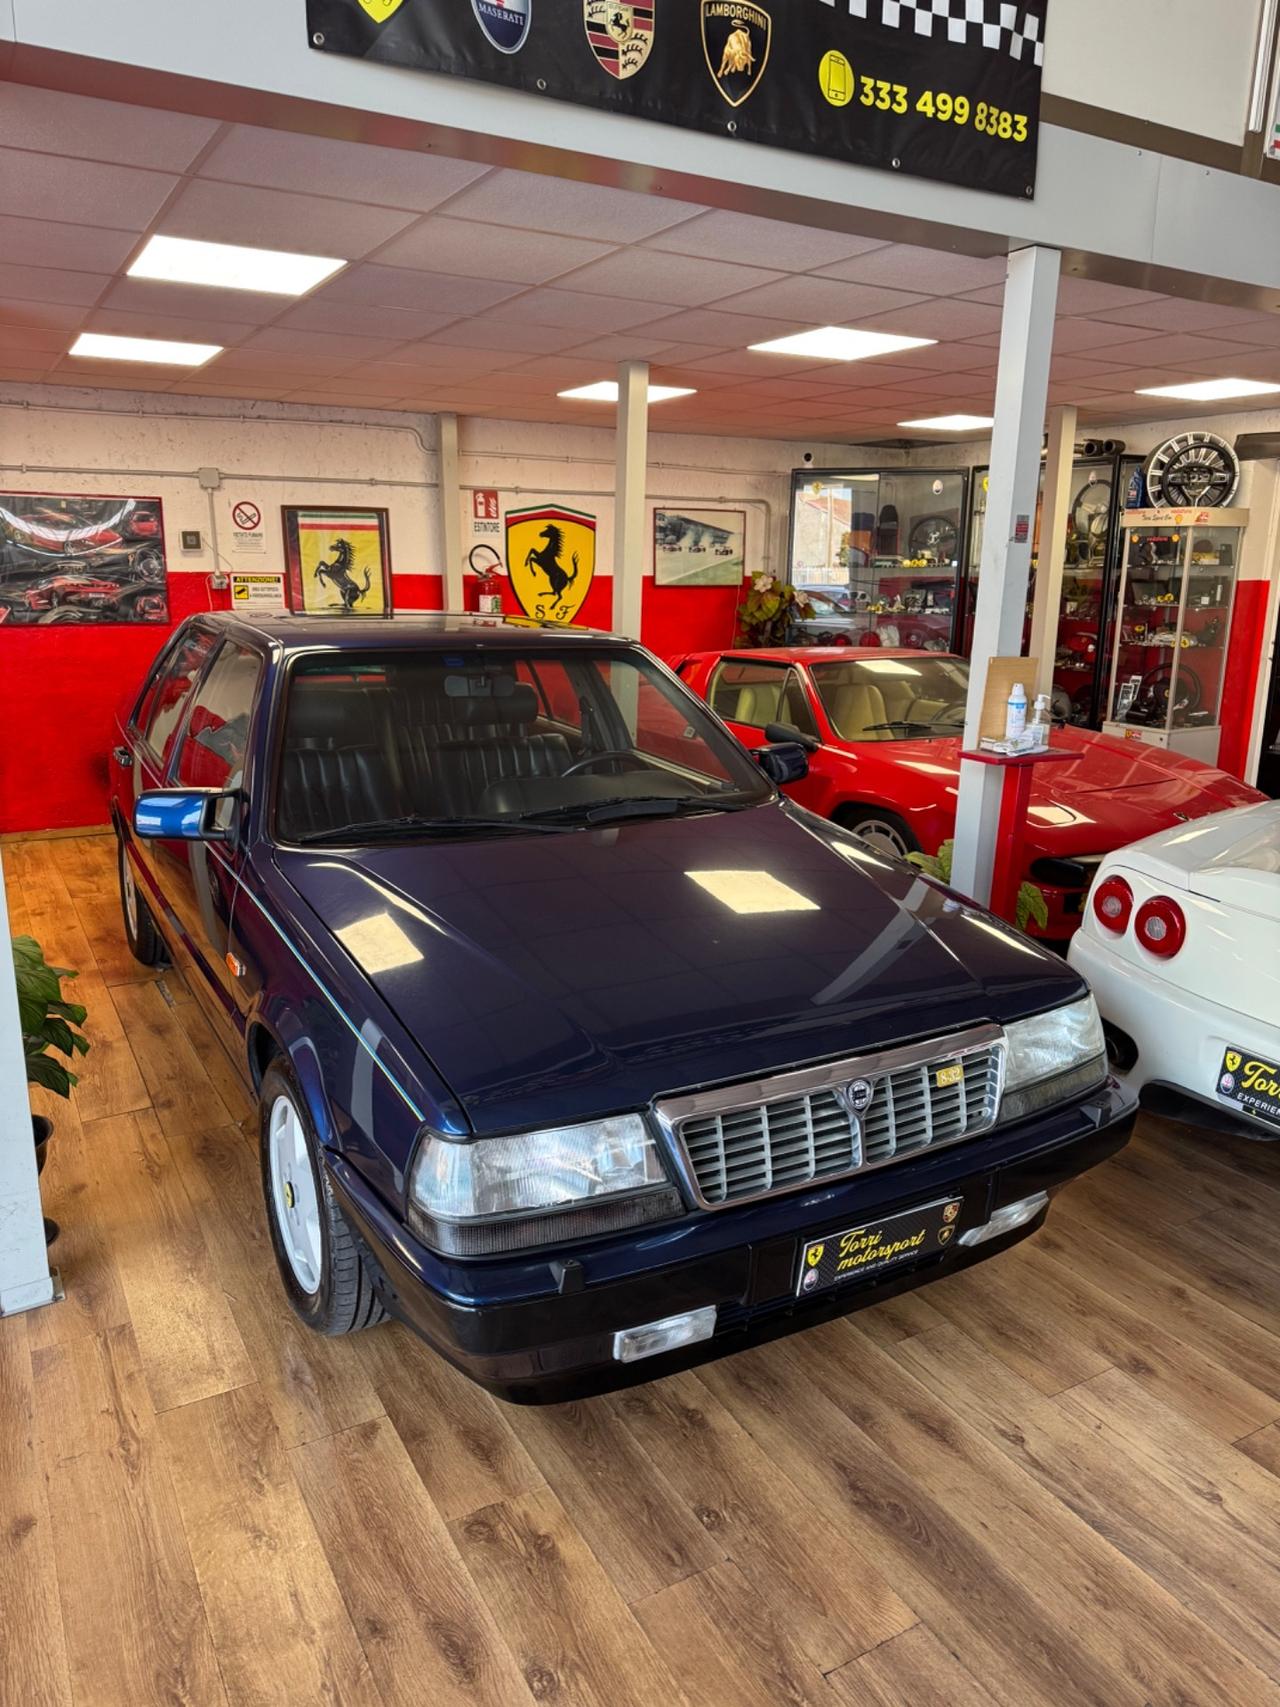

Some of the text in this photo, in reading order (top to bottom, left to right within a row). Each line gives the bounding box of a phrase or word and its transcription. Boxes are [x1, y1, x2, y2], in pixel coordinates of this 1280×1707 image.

[479, 2, 524, 26] MASERATI
[705, 3, 767, 31] LAMBORGHINI
[860, 76, 1028, 142] 333 499 8383
[535, 604, 545, 619] S
[837, 1229, 926, 1271] motorsport
[839, 1229, 883, 1257] Torri
